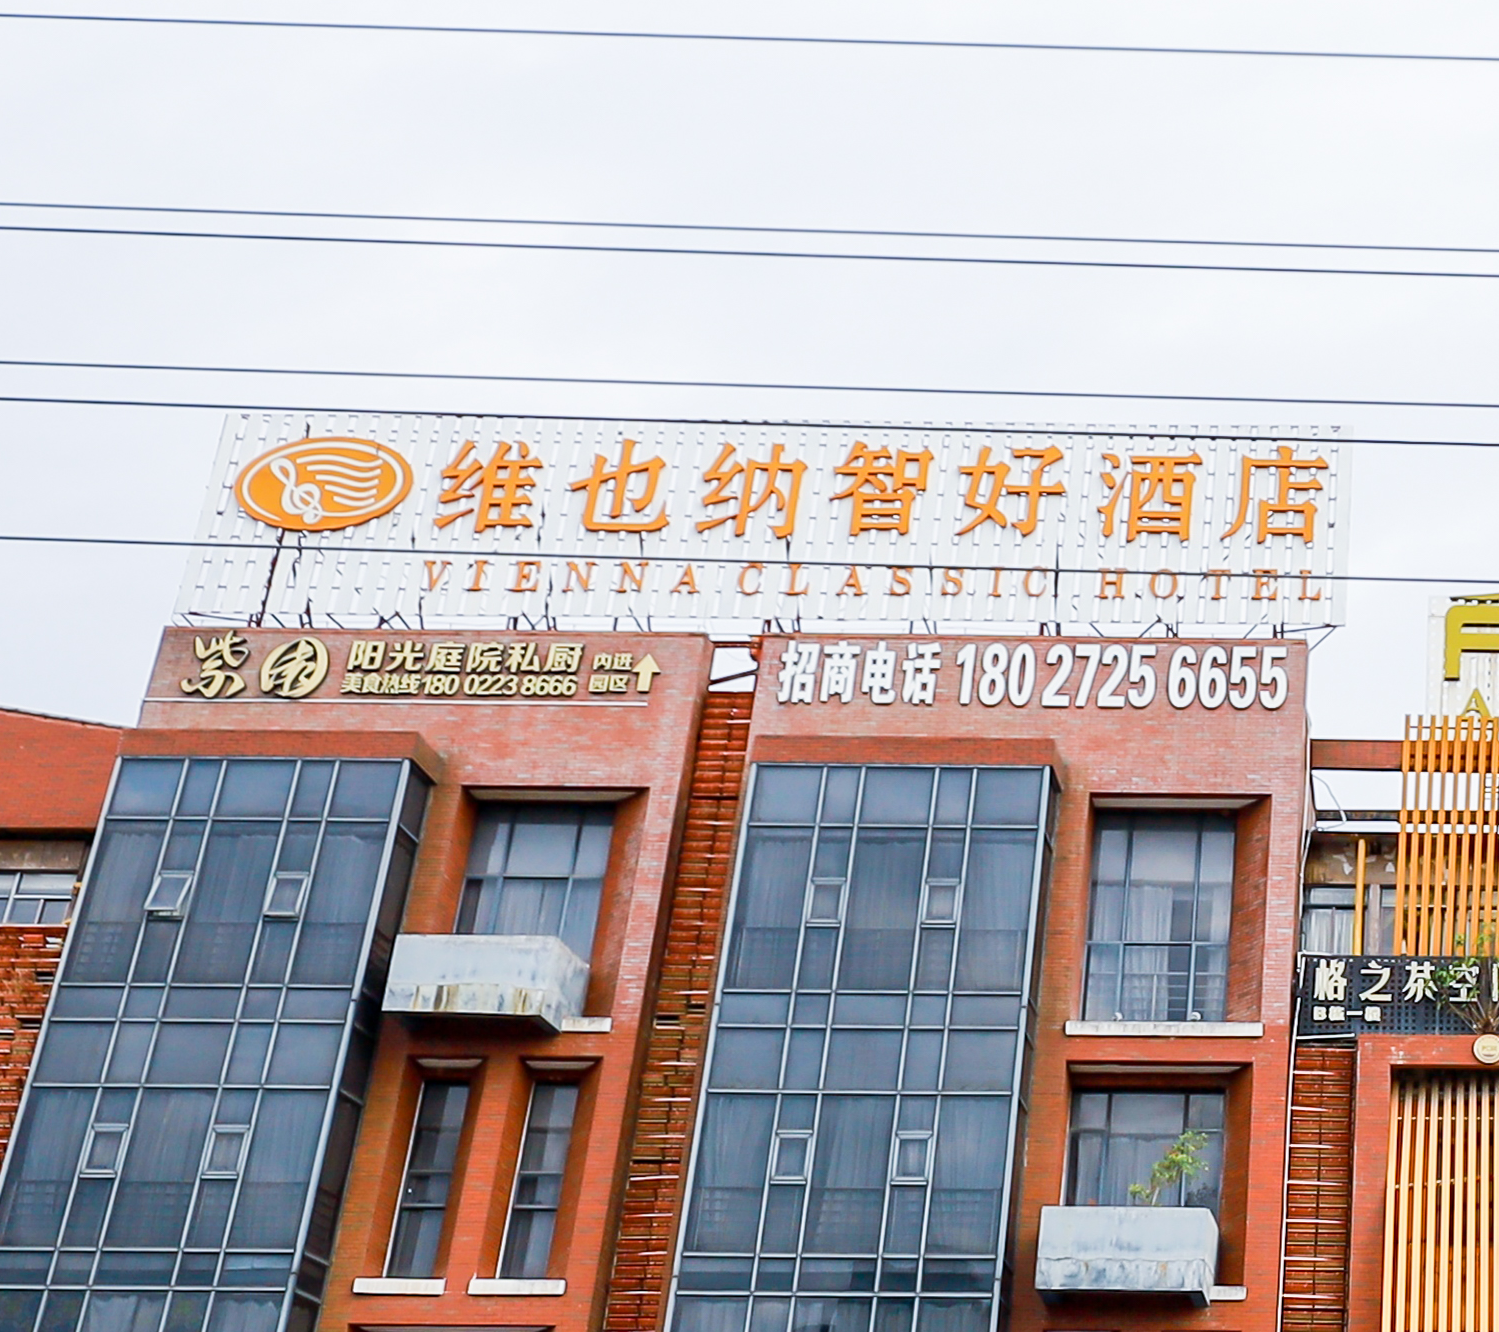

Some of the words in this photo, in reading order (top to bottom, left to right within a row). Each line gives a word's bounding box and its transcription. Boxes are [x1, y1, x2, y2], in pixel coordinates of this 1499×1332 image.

[432, 438, 1330, 546] 维也纳智好酒店
[422, 557, 702, 595] VIENNA
[736, 561, 1049, 598] CLASSIC
[1097, 567, 1323, 603] HOTEL
[346, 639, 584, 673] 阳光庭院私厨
[777, 641, 941, 705] 招商电话
[955, 643, 1037, 707] 180
[1041, 643, 1157, 709] 2725
[1167, 645, 1289, 710] 6655
[464, 673, 518, 696] 0223
[520, 674, 578, 696] 8666
